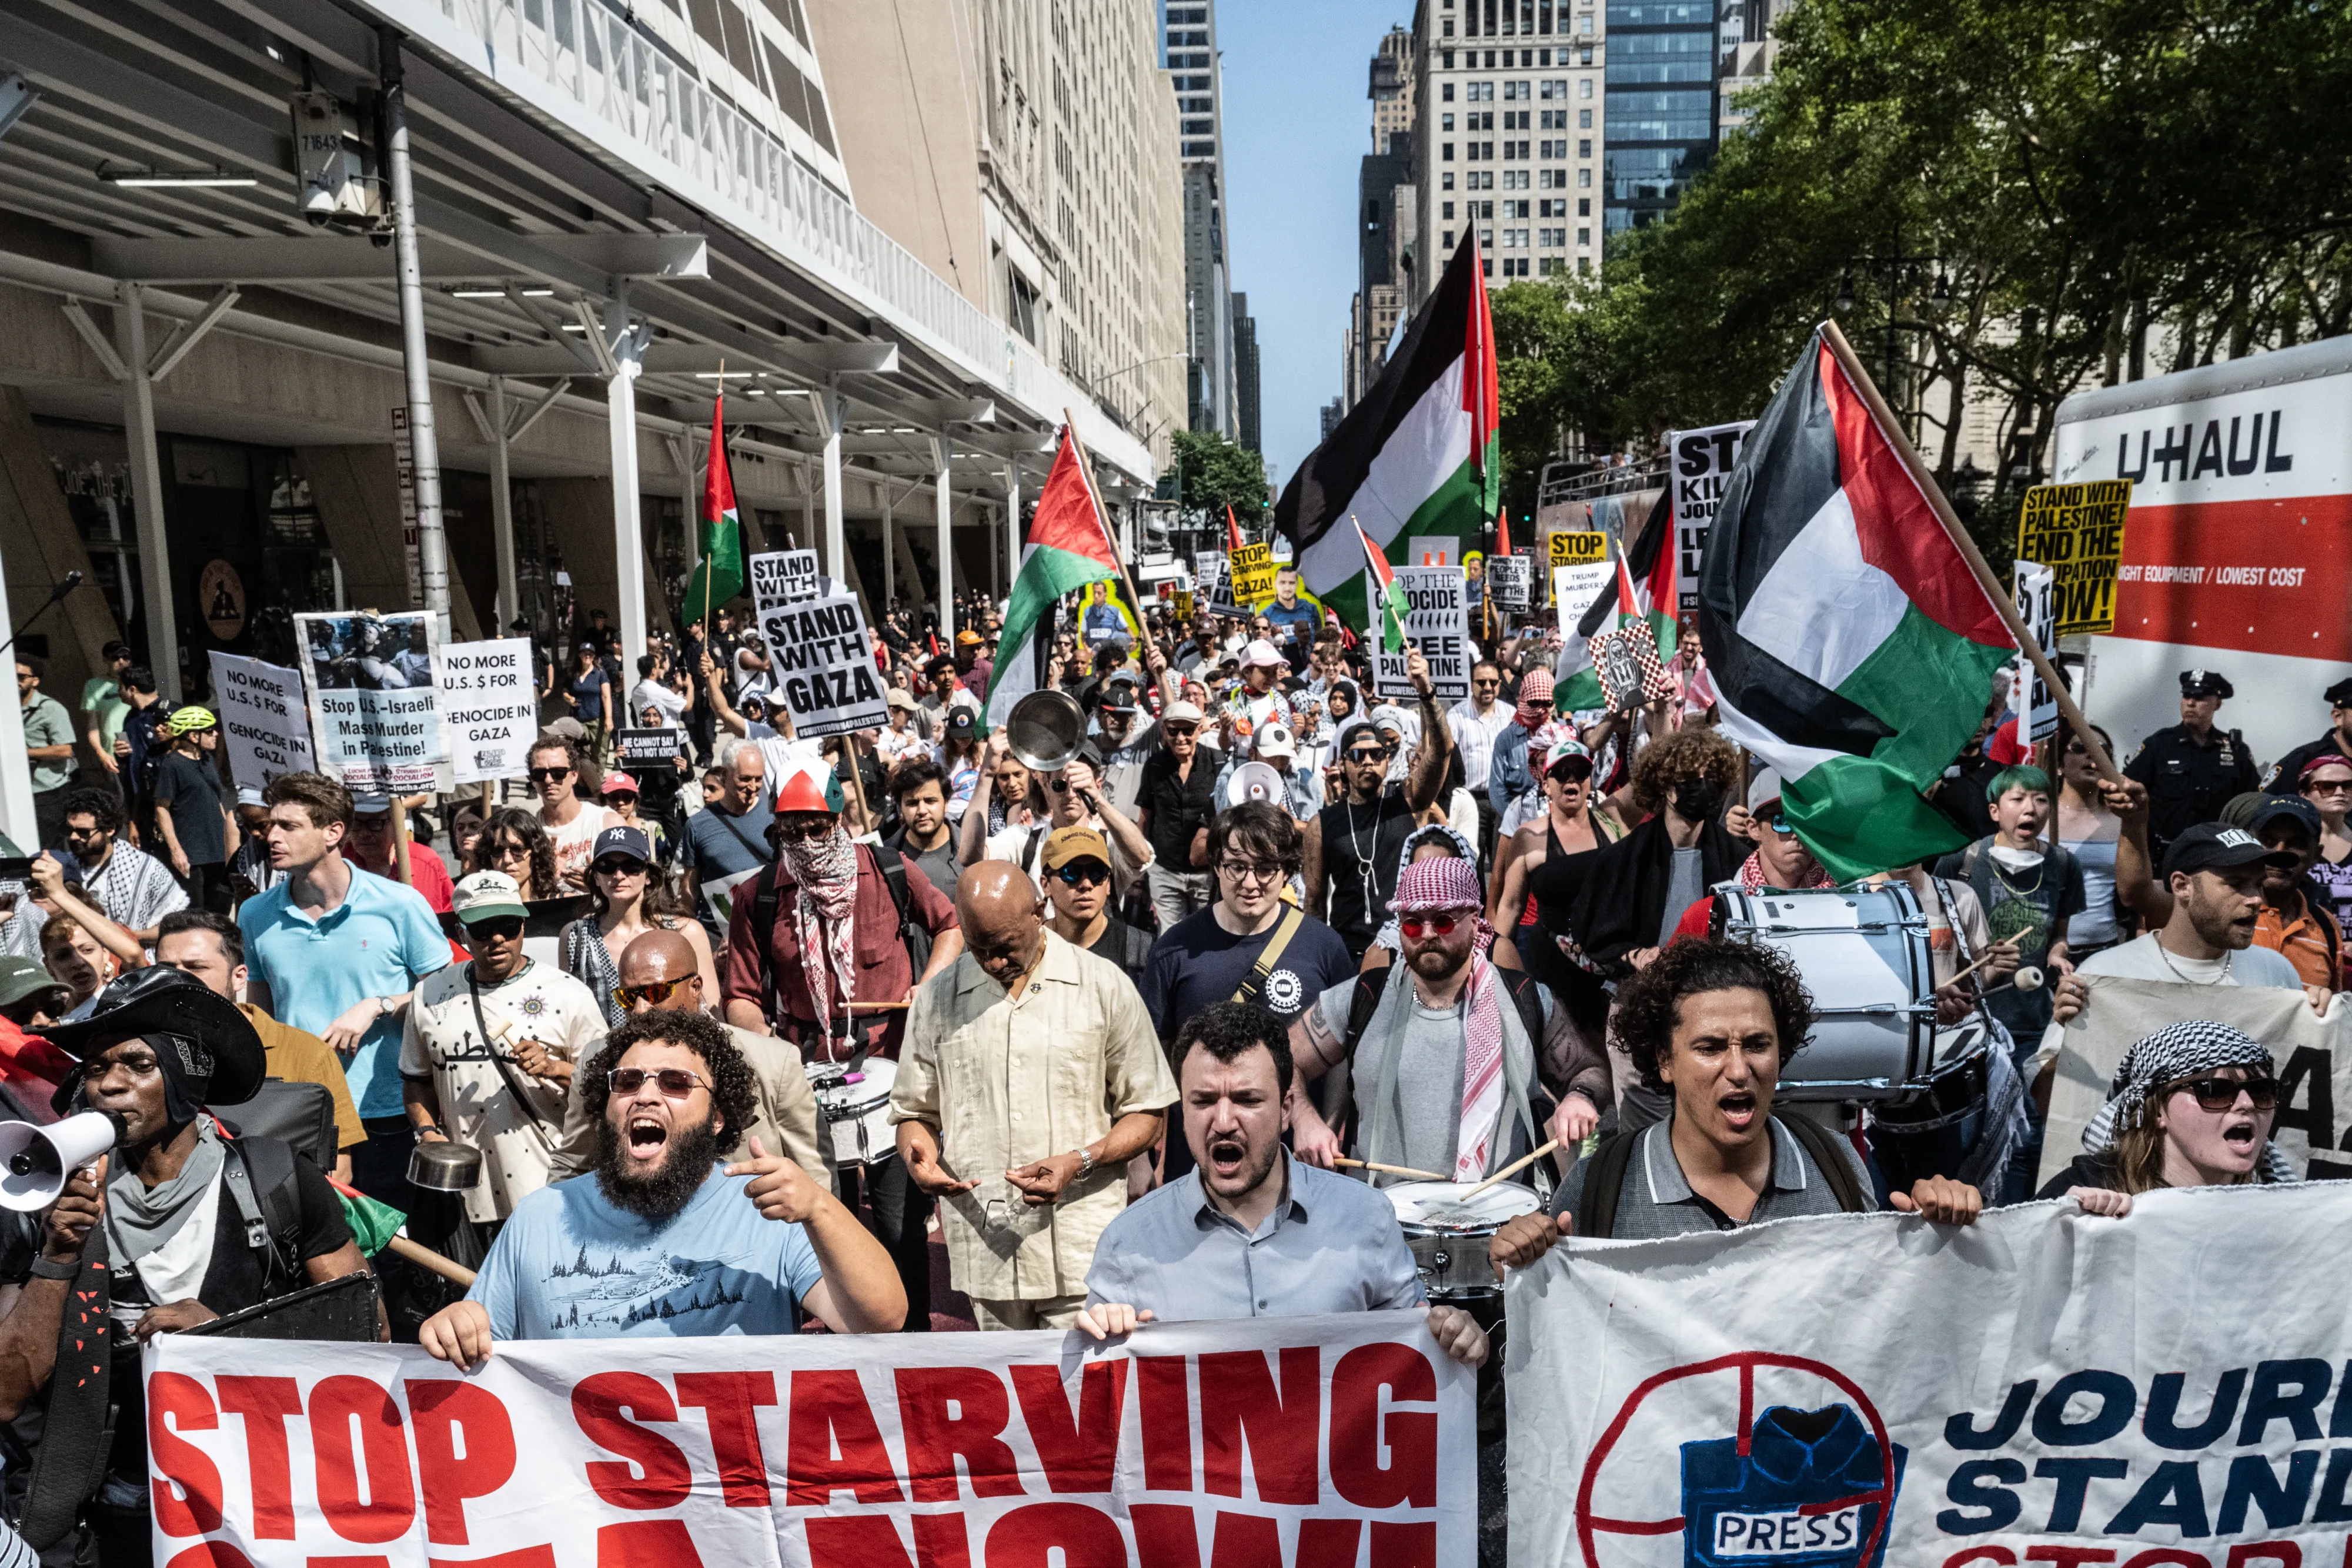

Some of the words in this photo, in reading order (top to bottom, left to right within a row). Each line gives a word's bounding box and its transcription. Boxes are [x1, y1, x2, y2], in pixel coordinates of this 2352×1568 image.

[1678, 429, 1753, 477] ST
[2027, 485, 2083, 510] STAND
[2087, 480, 2127, 503] WITH
[2025, 503, 2126, 533] PALESTINE!
[1552, 534, 1602, 554] STOP
[2021, 531, 2073, 562] END
[2079, 526, 2122, 558] THE
[1231, 546, 1266, 566] STOP
[754, 556, 814, 579] STAND
[1232, 561, 1271, 576] STARVING
[1571, 572, 1599, 581] TRUMP
[2144, 566, 2205, 583] EQUIPMENT
[2216, 567, 2266, 586] LOWEST
[2269, 568, 2306, 587] COST
[756, 574, 816, 595] WITH
[1235, 577, 1272, 596] GAZA!
[1421, 574, 1456, 588] THE
[1566, 582, 1606, 591] MURDERS
[1375, 590, 1458, 610] GOCIDE
[1573, 601, 1596, 610] GAZ
[2054, 579, 2112, 624] OW!
[765, 603, 857, 647] STAND
[447, 657, 470, 670] NO
[475, 654, 516, 668] MORE
[773, 633, 867, 671] WITH
[1381, 658, 1462, 676] PALTINE
[227, 670, 248, 686] NO
[249, 676, 283, 697] MORE
[444, 677, 472, 690] U.S.
[477, 674, 485, 690] $
[490, 674, 517, 687] FOR
[786, 666, 880, 714] GAZA
[227, 688, 252, 705] U.S.
[265, 698, 288, 717] FOR
[322, 698, 355, 716] Stop
[518, 705, 530, 717] IN
[229, 722, 288, 750] GENOCIDE
[290, 740, 306, 753] IN
[339, 721, 374, 735] Mass
[375, 721, 424, 737] Murder
[469, 727, 511, 741] GAZA
[343, 741, 356, 755] in
[360, 740, 426, 757] Palestine!
[622, 737, 633, 748] WE
[633, 737, 660, 747] CANNOT
[661, 736, 674, 746] SAY
[632, 748, 643, 757] DID
[644, 747, 657, 757] NOT
[659, 747, 679, 757] KNOW
[254, 747, 288, 768] GAZA
[393, 772, 434, 781] SOCIALISM
[1277, 984, 1292, 992] UAW
[1269, 1004, 1293, 1014] REGION
[570, 1342, 1438, 1510] STARVING
[147, 1370, 516, 1544] STOP
[1718, 1511, 1855, 1550] PRESS
